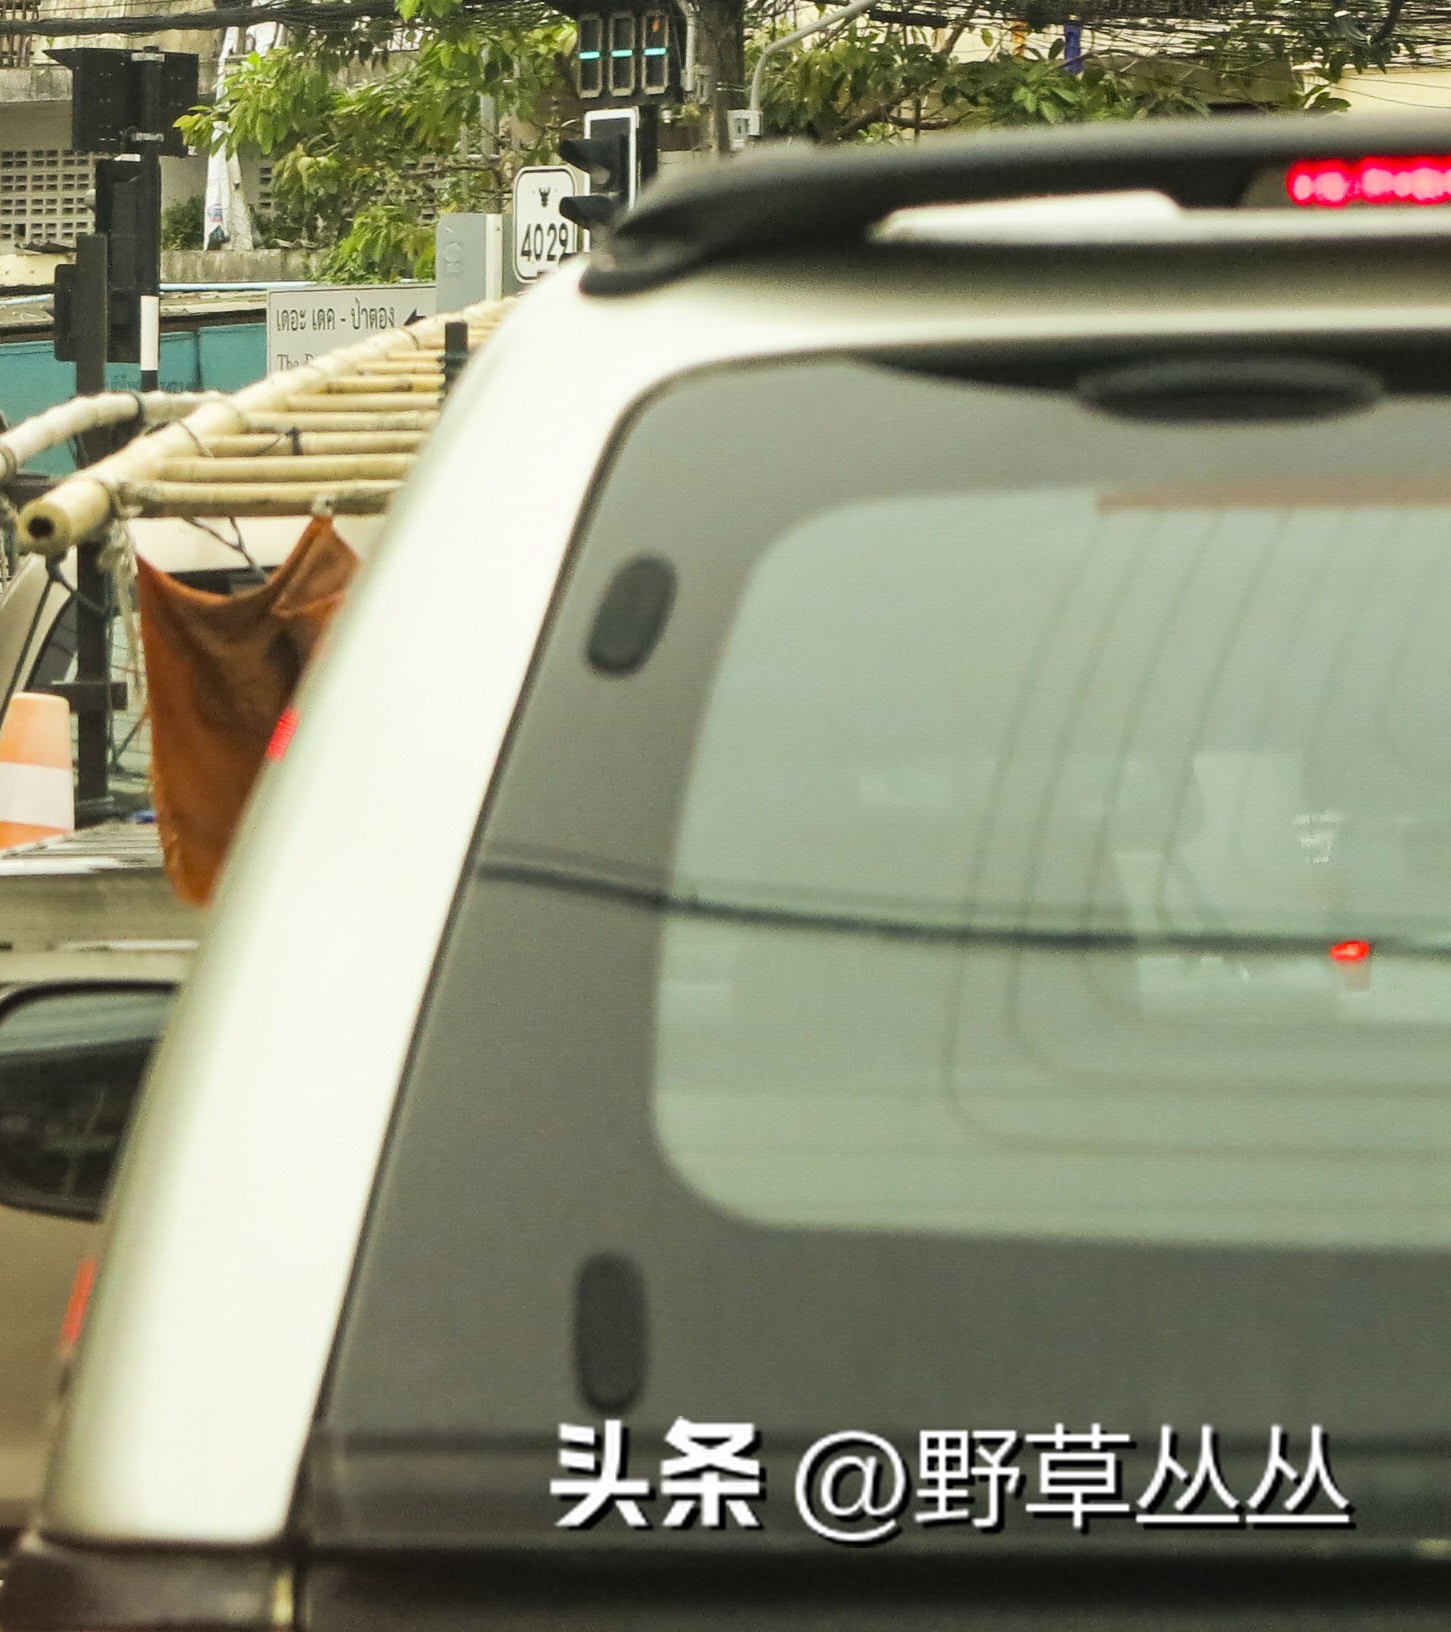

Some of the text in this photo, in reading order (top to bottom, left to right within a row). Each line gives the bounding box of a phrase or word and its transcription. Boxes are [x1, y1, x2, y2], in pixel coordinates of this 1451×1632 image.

[520, 222, 570, 263] 4029
[275, 306, 307, 332] เดอะ
[350, 296, 397, 331] ป่าตอง
